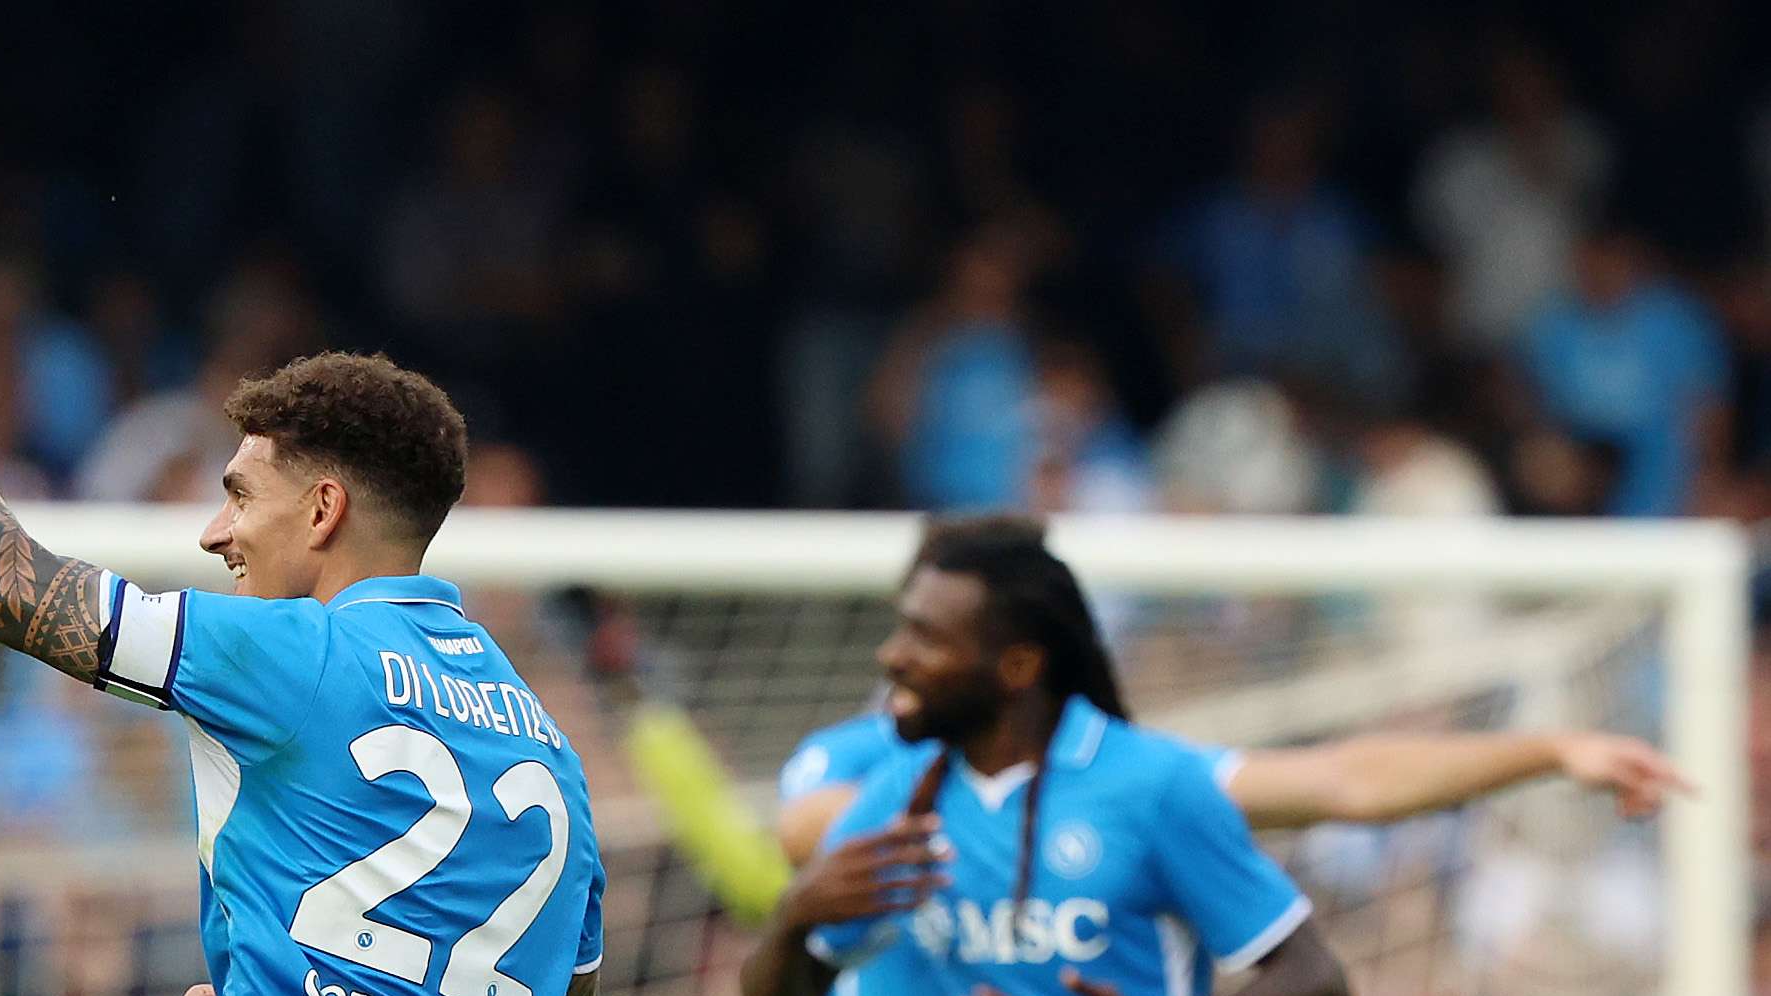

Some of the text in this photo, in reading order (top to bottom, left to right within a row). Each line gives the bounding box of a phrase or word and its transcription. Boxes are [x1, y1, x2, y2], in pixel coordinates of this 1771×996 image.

[379, 651, 561, 750] DI LORENZO
[958, 897, 1109, 965] MSC
